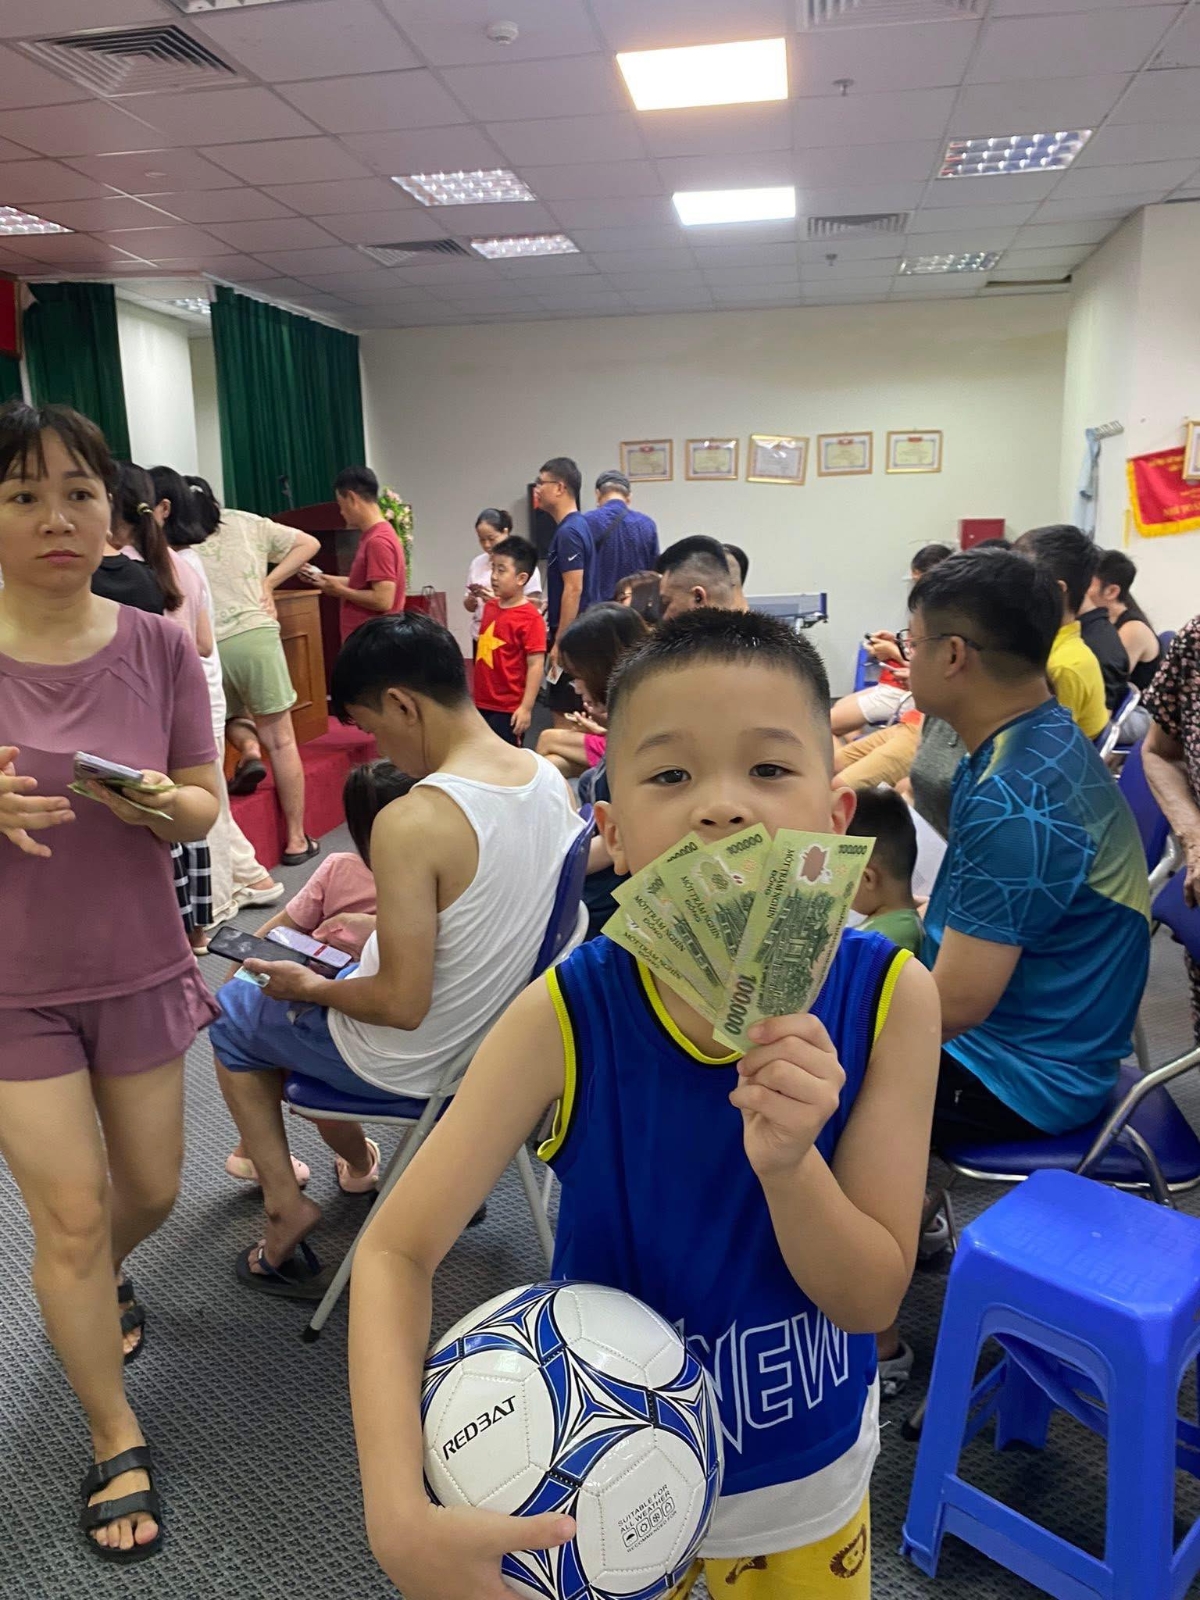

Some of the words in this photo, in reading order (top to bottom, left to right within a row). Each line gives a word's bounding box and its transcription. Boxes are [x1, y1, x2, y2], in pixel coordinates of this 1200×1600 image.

[618, 1497, 652, 1526] SUITABLE
[653, 1484, 667, 1497] FOR
[620, 1521, 634, 1533] ALL
[635, 1490, 670, 1521] WEATHER
